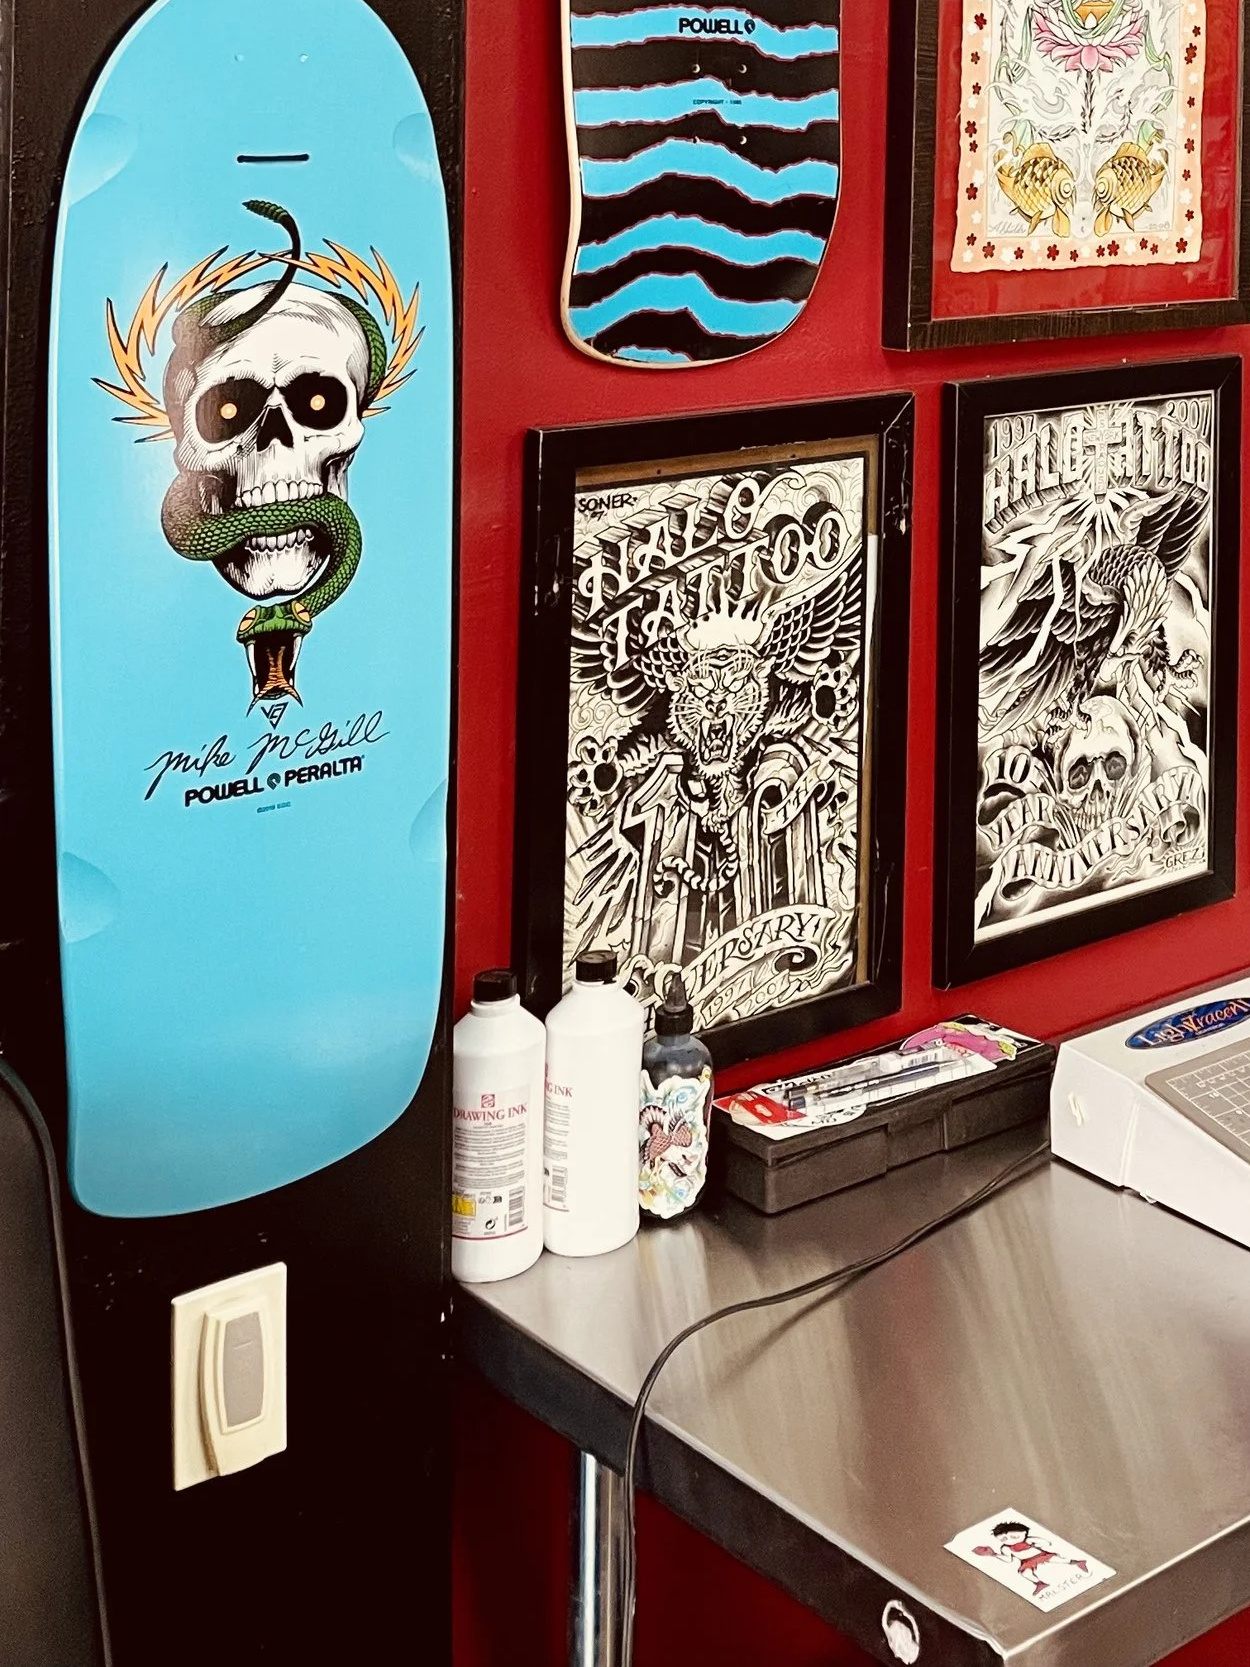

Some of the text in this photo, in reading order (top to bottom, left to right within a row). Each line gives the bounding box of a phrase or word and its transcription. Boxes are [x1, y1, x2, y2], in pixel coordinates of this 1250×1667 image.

[679, 18, 744, 35] POWELL
[991, 400, 1212, 460] 1997 2007
[984, 412, 1086, 528] HALO
[578, 469, 807, 621] HALO
[602, 510, 852, 672] TATTOO
[185, 777, 264, 807] POWELL
[284, 755, 362, 788] PERALTA
[995, 752, 1031, 784] 10
[989, 795, 1052, 846] YEAR
[1013, 772, 1196, 883] ANNIVERSARY!
[454, 1103, 527, 1122] DRAWING INK
[554, 1085, 573, 1098] INK
